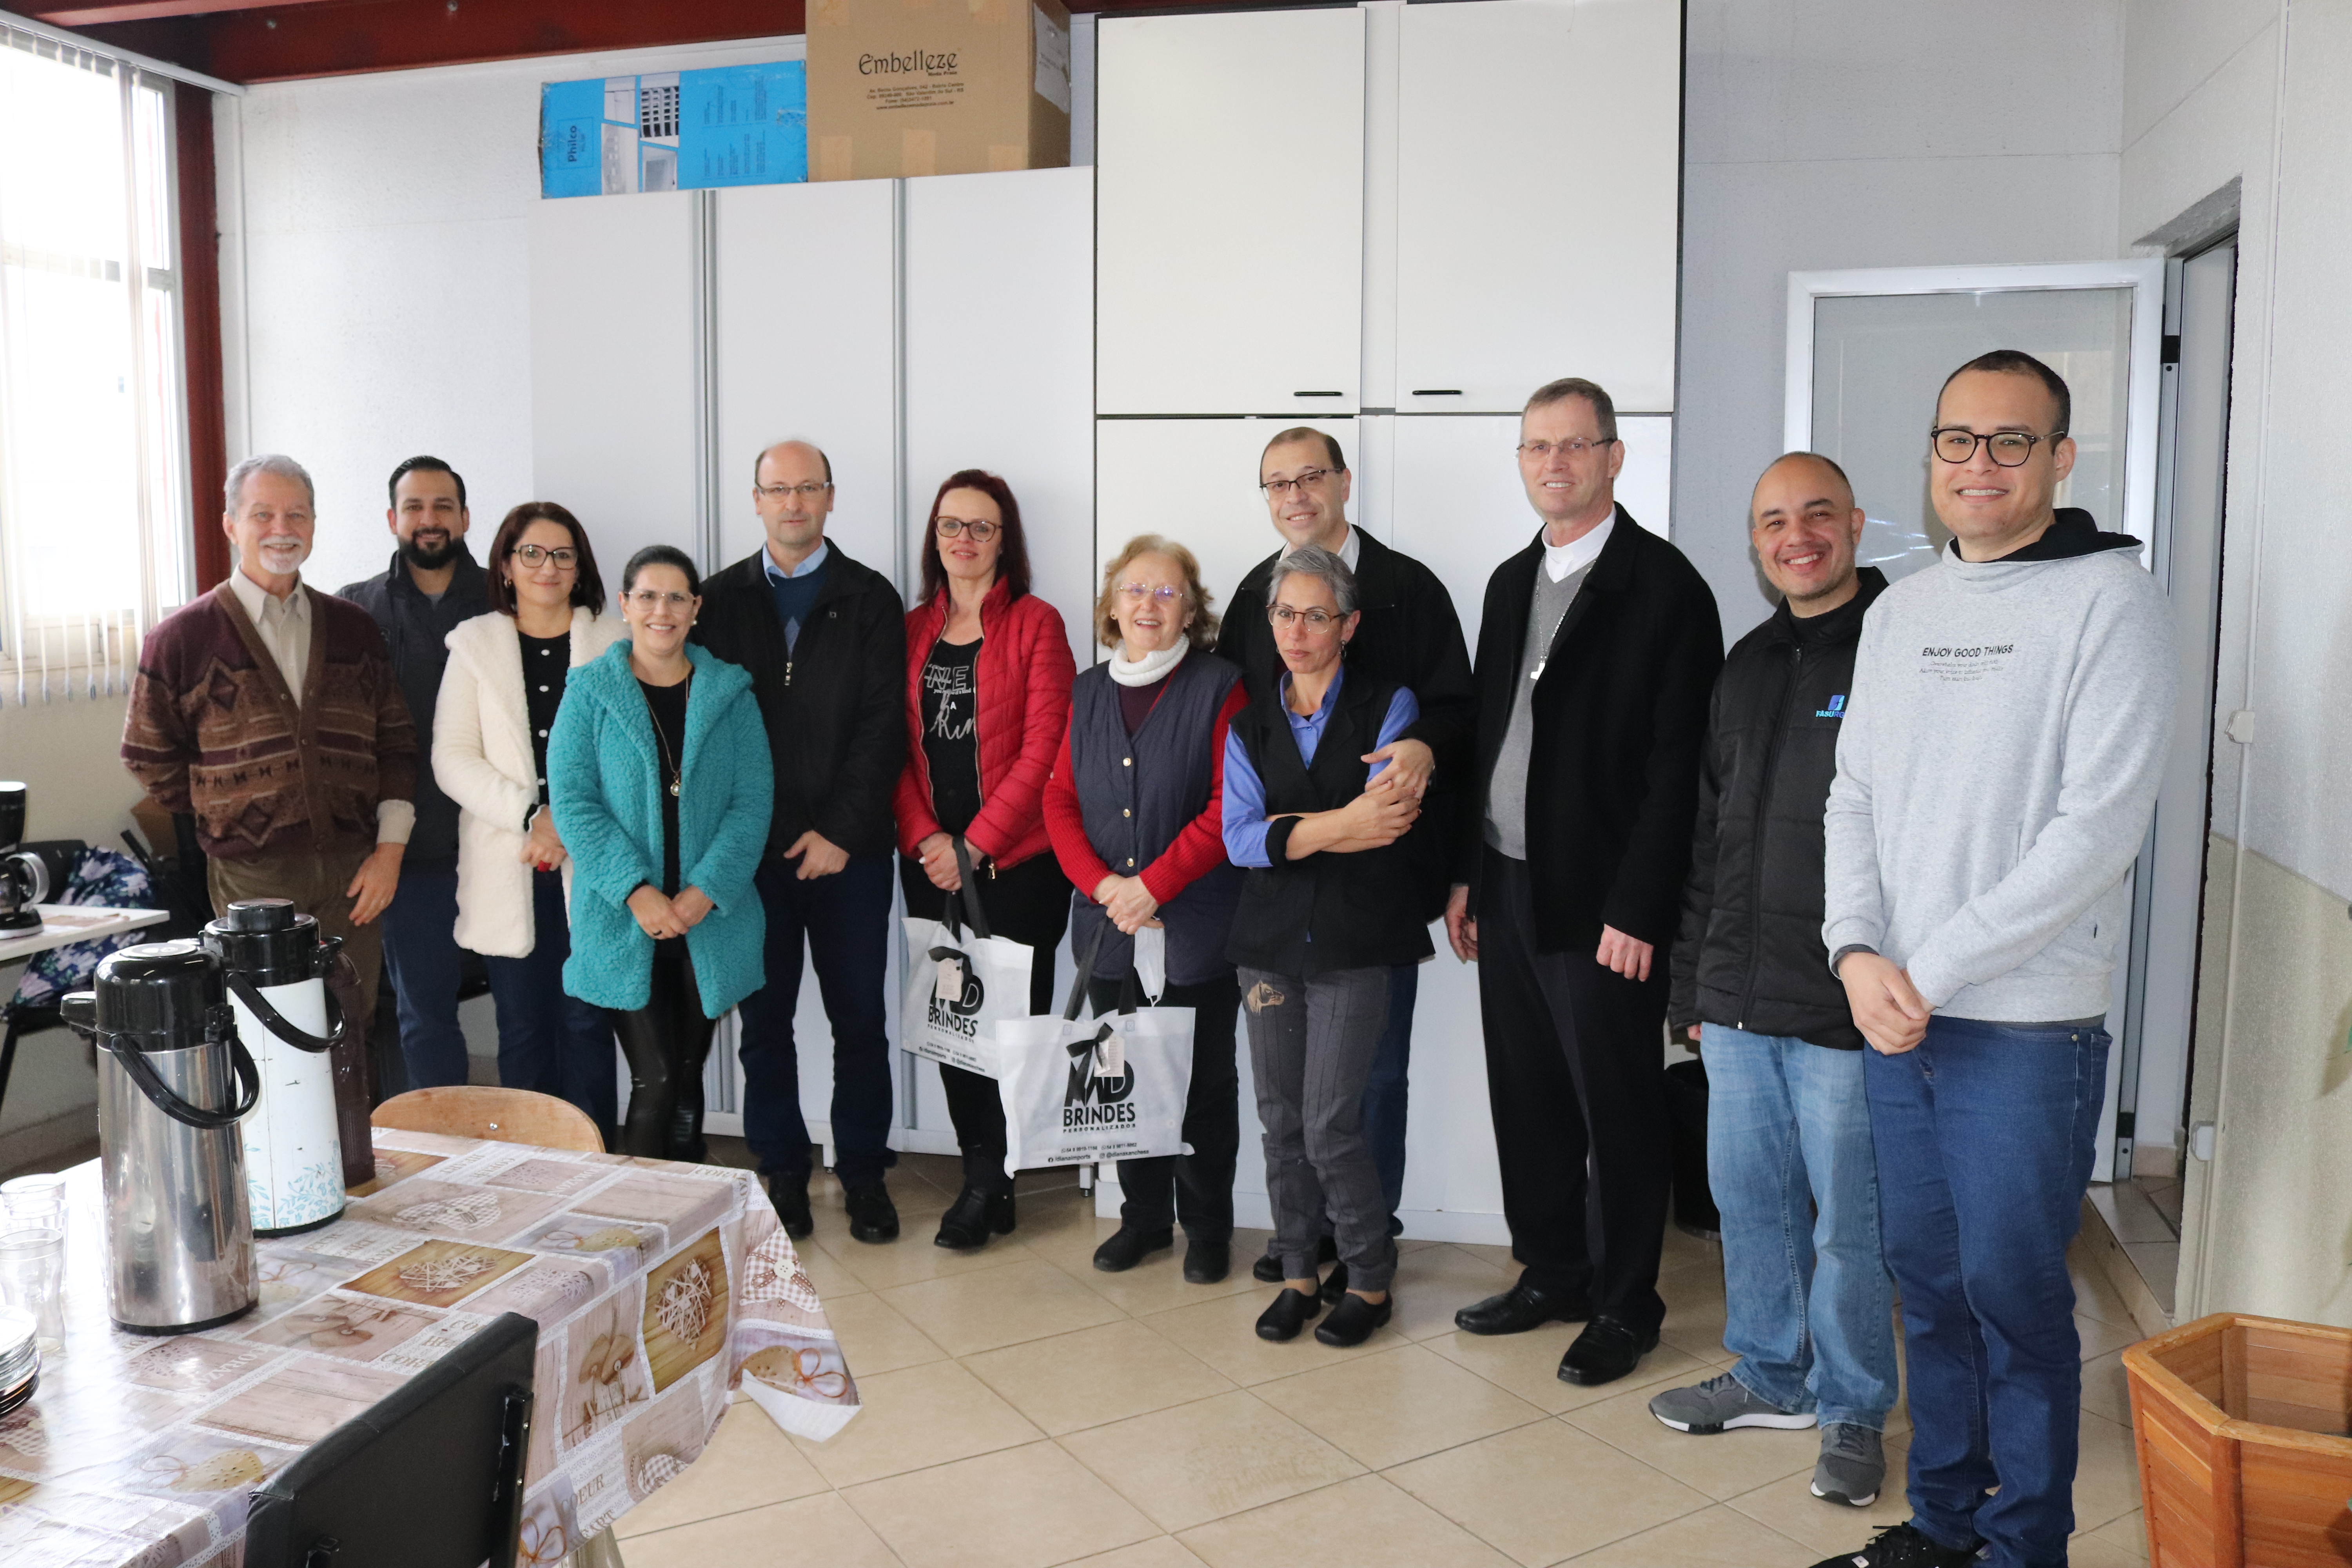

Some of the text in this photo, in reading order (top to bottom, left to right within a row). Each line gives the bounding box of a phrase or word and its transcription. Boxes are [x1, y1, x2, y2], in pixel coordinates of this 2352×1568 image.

[859, 49, 957, 74] Embelleze
[568, 125, 577, 162] Philco
[1922, 644, 2014, 657] ENJOY GOOD THINGS
[950, 701, 957, 710] A
[928, 1006, 978, 1038] BRINDES
[1063, 1102, 1135, 1127] BRINDES
[1063, 1123, 1136, 1134] PERSONALIZADOS
